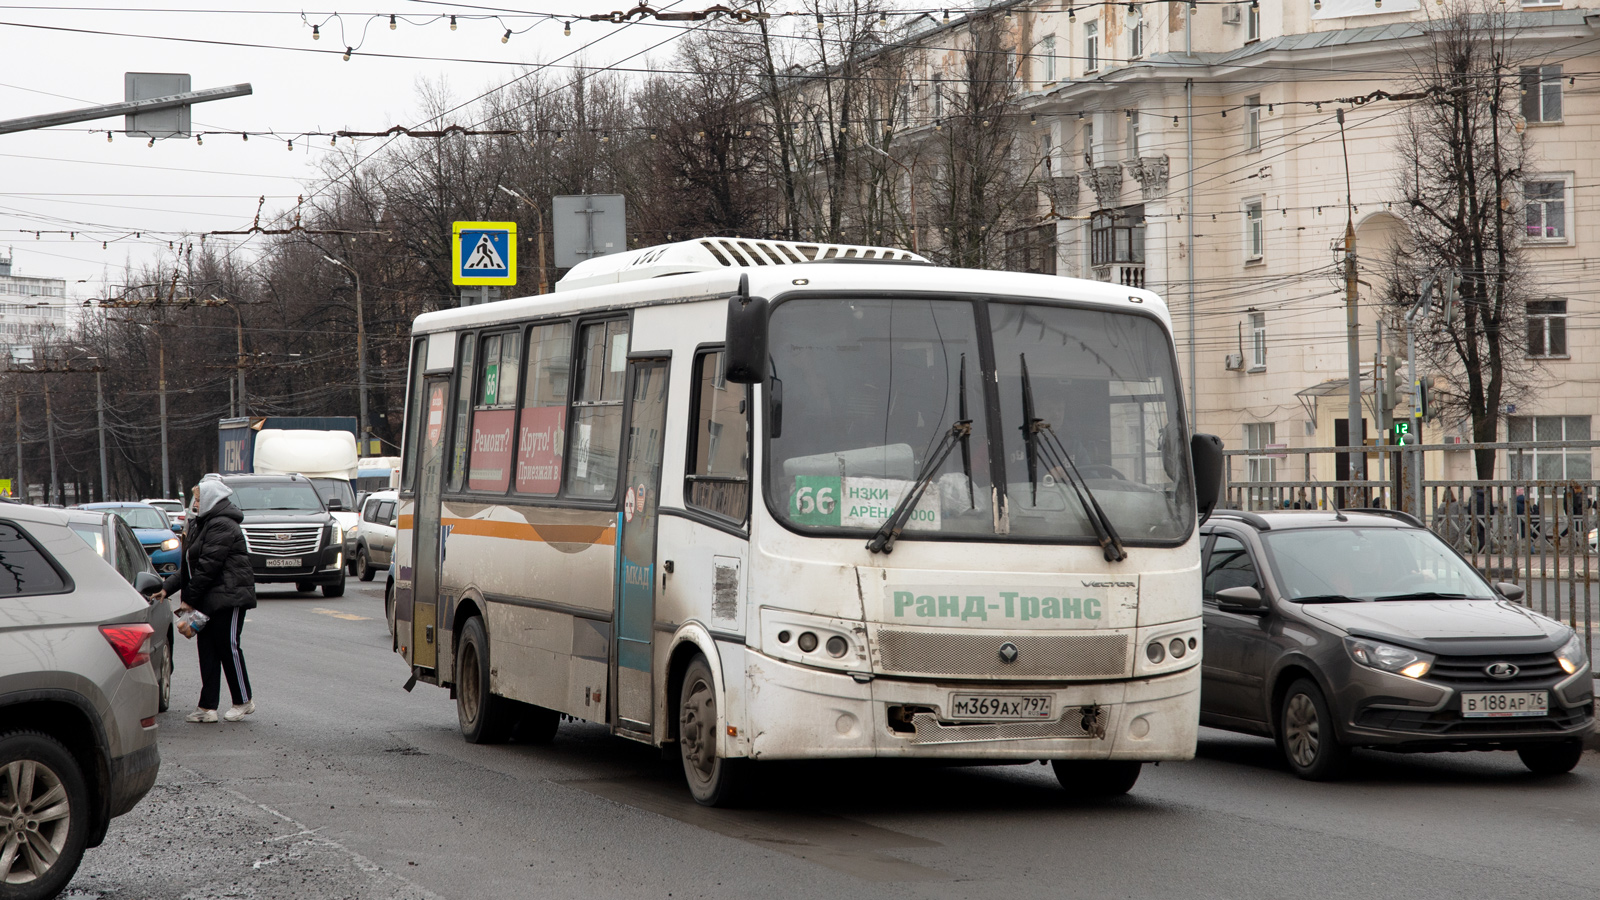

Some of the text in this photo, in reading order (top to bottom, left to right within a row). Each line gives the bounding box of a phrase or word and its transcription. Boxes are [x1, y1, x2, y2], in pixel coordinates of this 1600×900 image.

[473, 427, 510, 452] Ремонт?
[1395, 423, 1409, 434] 12
[520, 426, 551, 458] Круто!
[224, 440, 244, 471] ПЭК
[518, 460, 559, 485] Приезжай в
[796, 486, 835, 515] 66
[849, 486, 889, 500] НЗКИ
[848, 505, 935, 522] АРЕНА 000
[625, 565, 650, 590] МКАД
[893, 591, 1102, 621] Ранд-Транс
[1023, 698, 1047, 711] 797
[1529, 693, 1544, 705] 76
